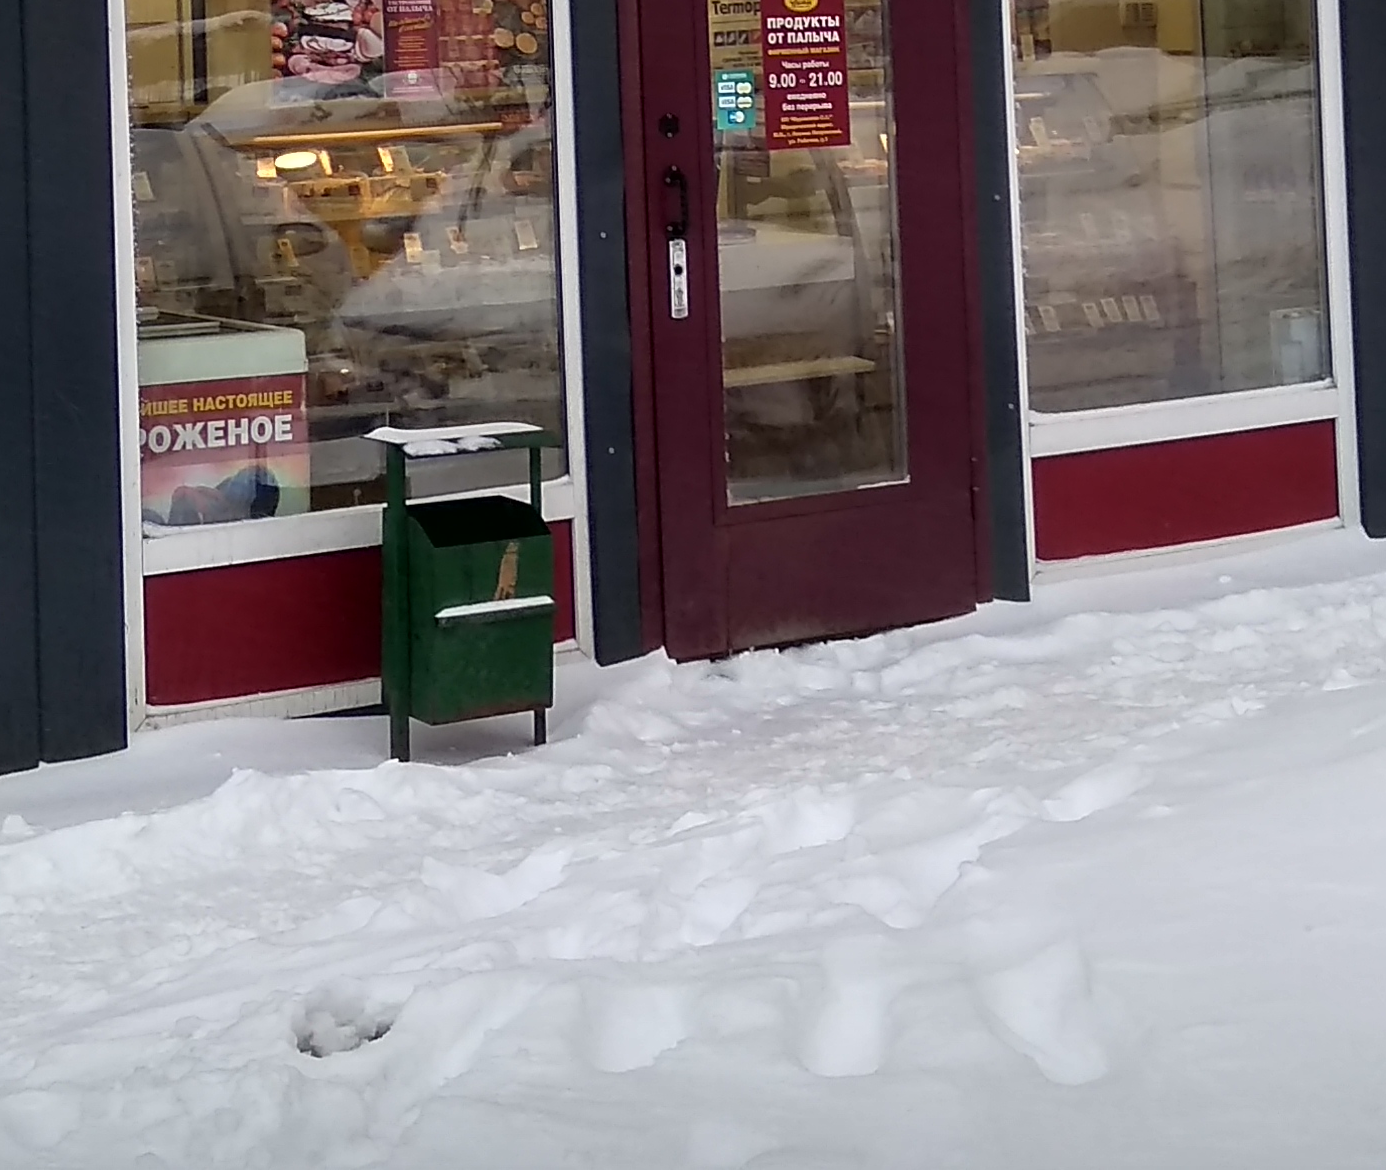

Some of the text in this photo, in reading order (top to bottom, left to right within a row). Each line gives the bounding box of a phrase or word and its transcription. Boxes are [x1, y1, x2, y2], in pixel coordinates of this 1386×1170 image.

[766, 16, 840, 30] ПРОДУКТЫ
[767, 30, 840, 44] ОТ ПАЛЫЧА
[781, 60, 830, 70] Часы работы
[769, 73, 796, 88] 9.00
[808, 71, 843, 87] 21.00
[193, 390, 293, 412] НАСТОЯЩЕЕ
